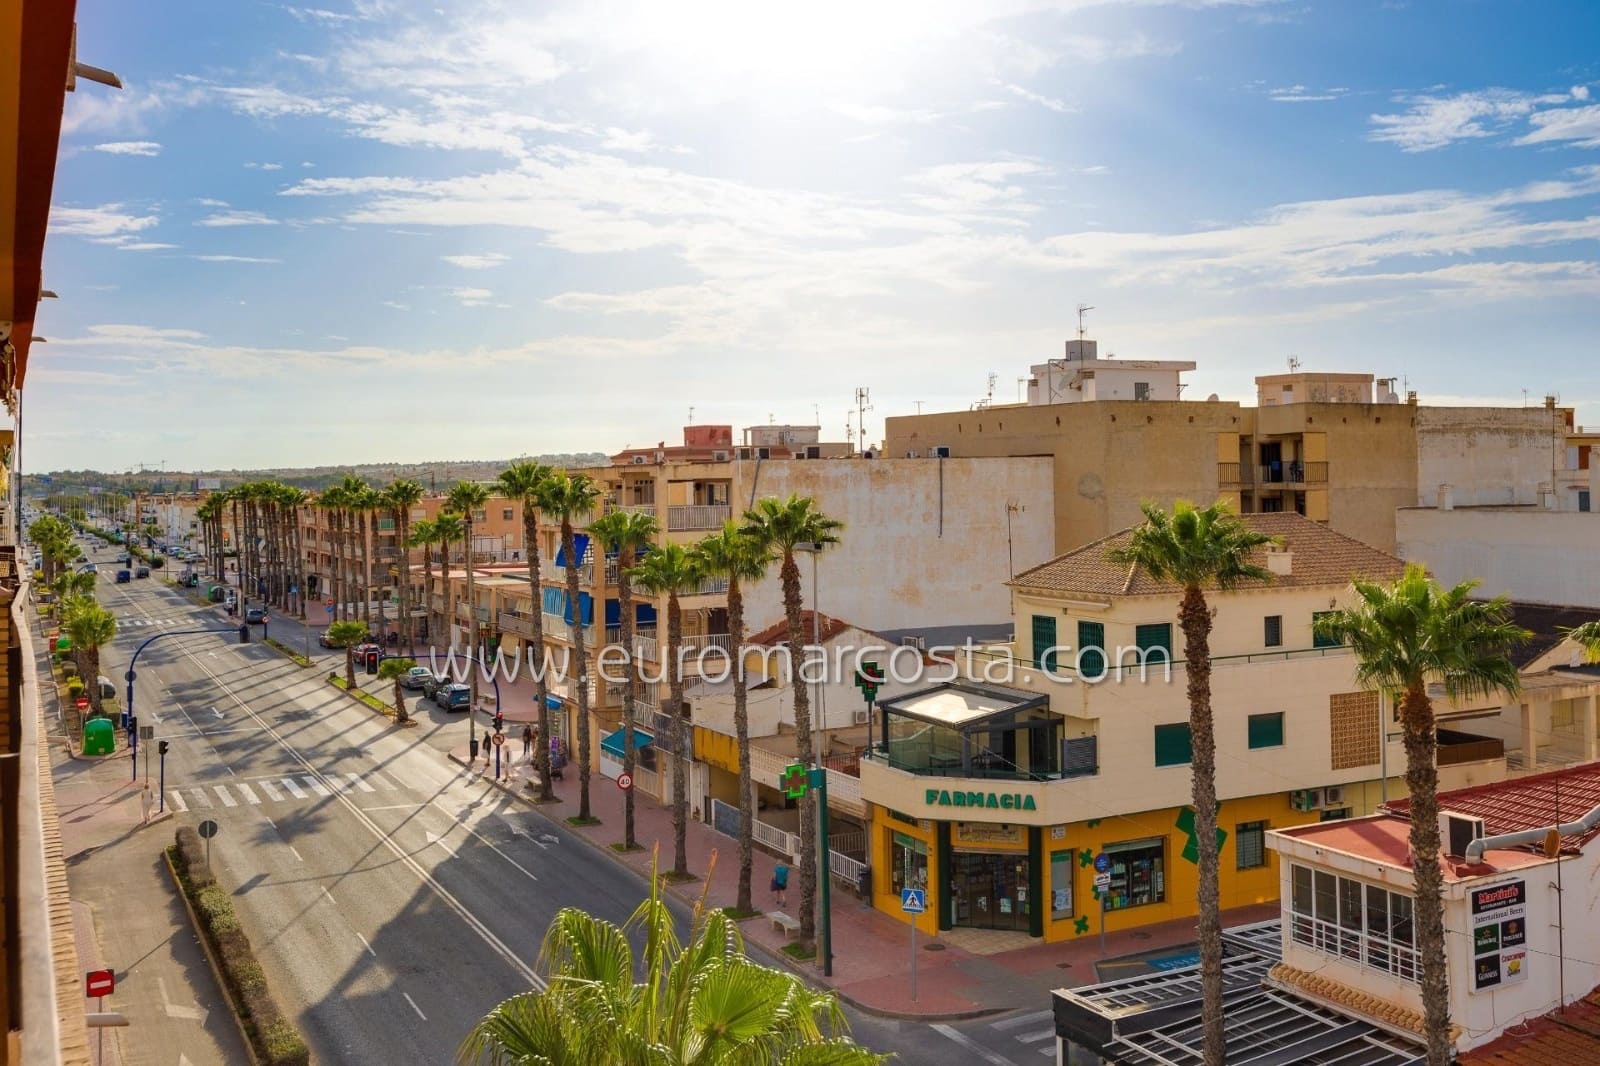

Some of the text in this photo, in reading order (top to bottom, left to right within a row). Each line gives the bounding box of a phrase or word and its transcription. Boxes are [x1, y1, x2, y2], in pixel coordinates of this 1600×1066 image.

[925, 789, 1037, 811] FARMACIA
[1475, 907, 1524, 924] International Beers
